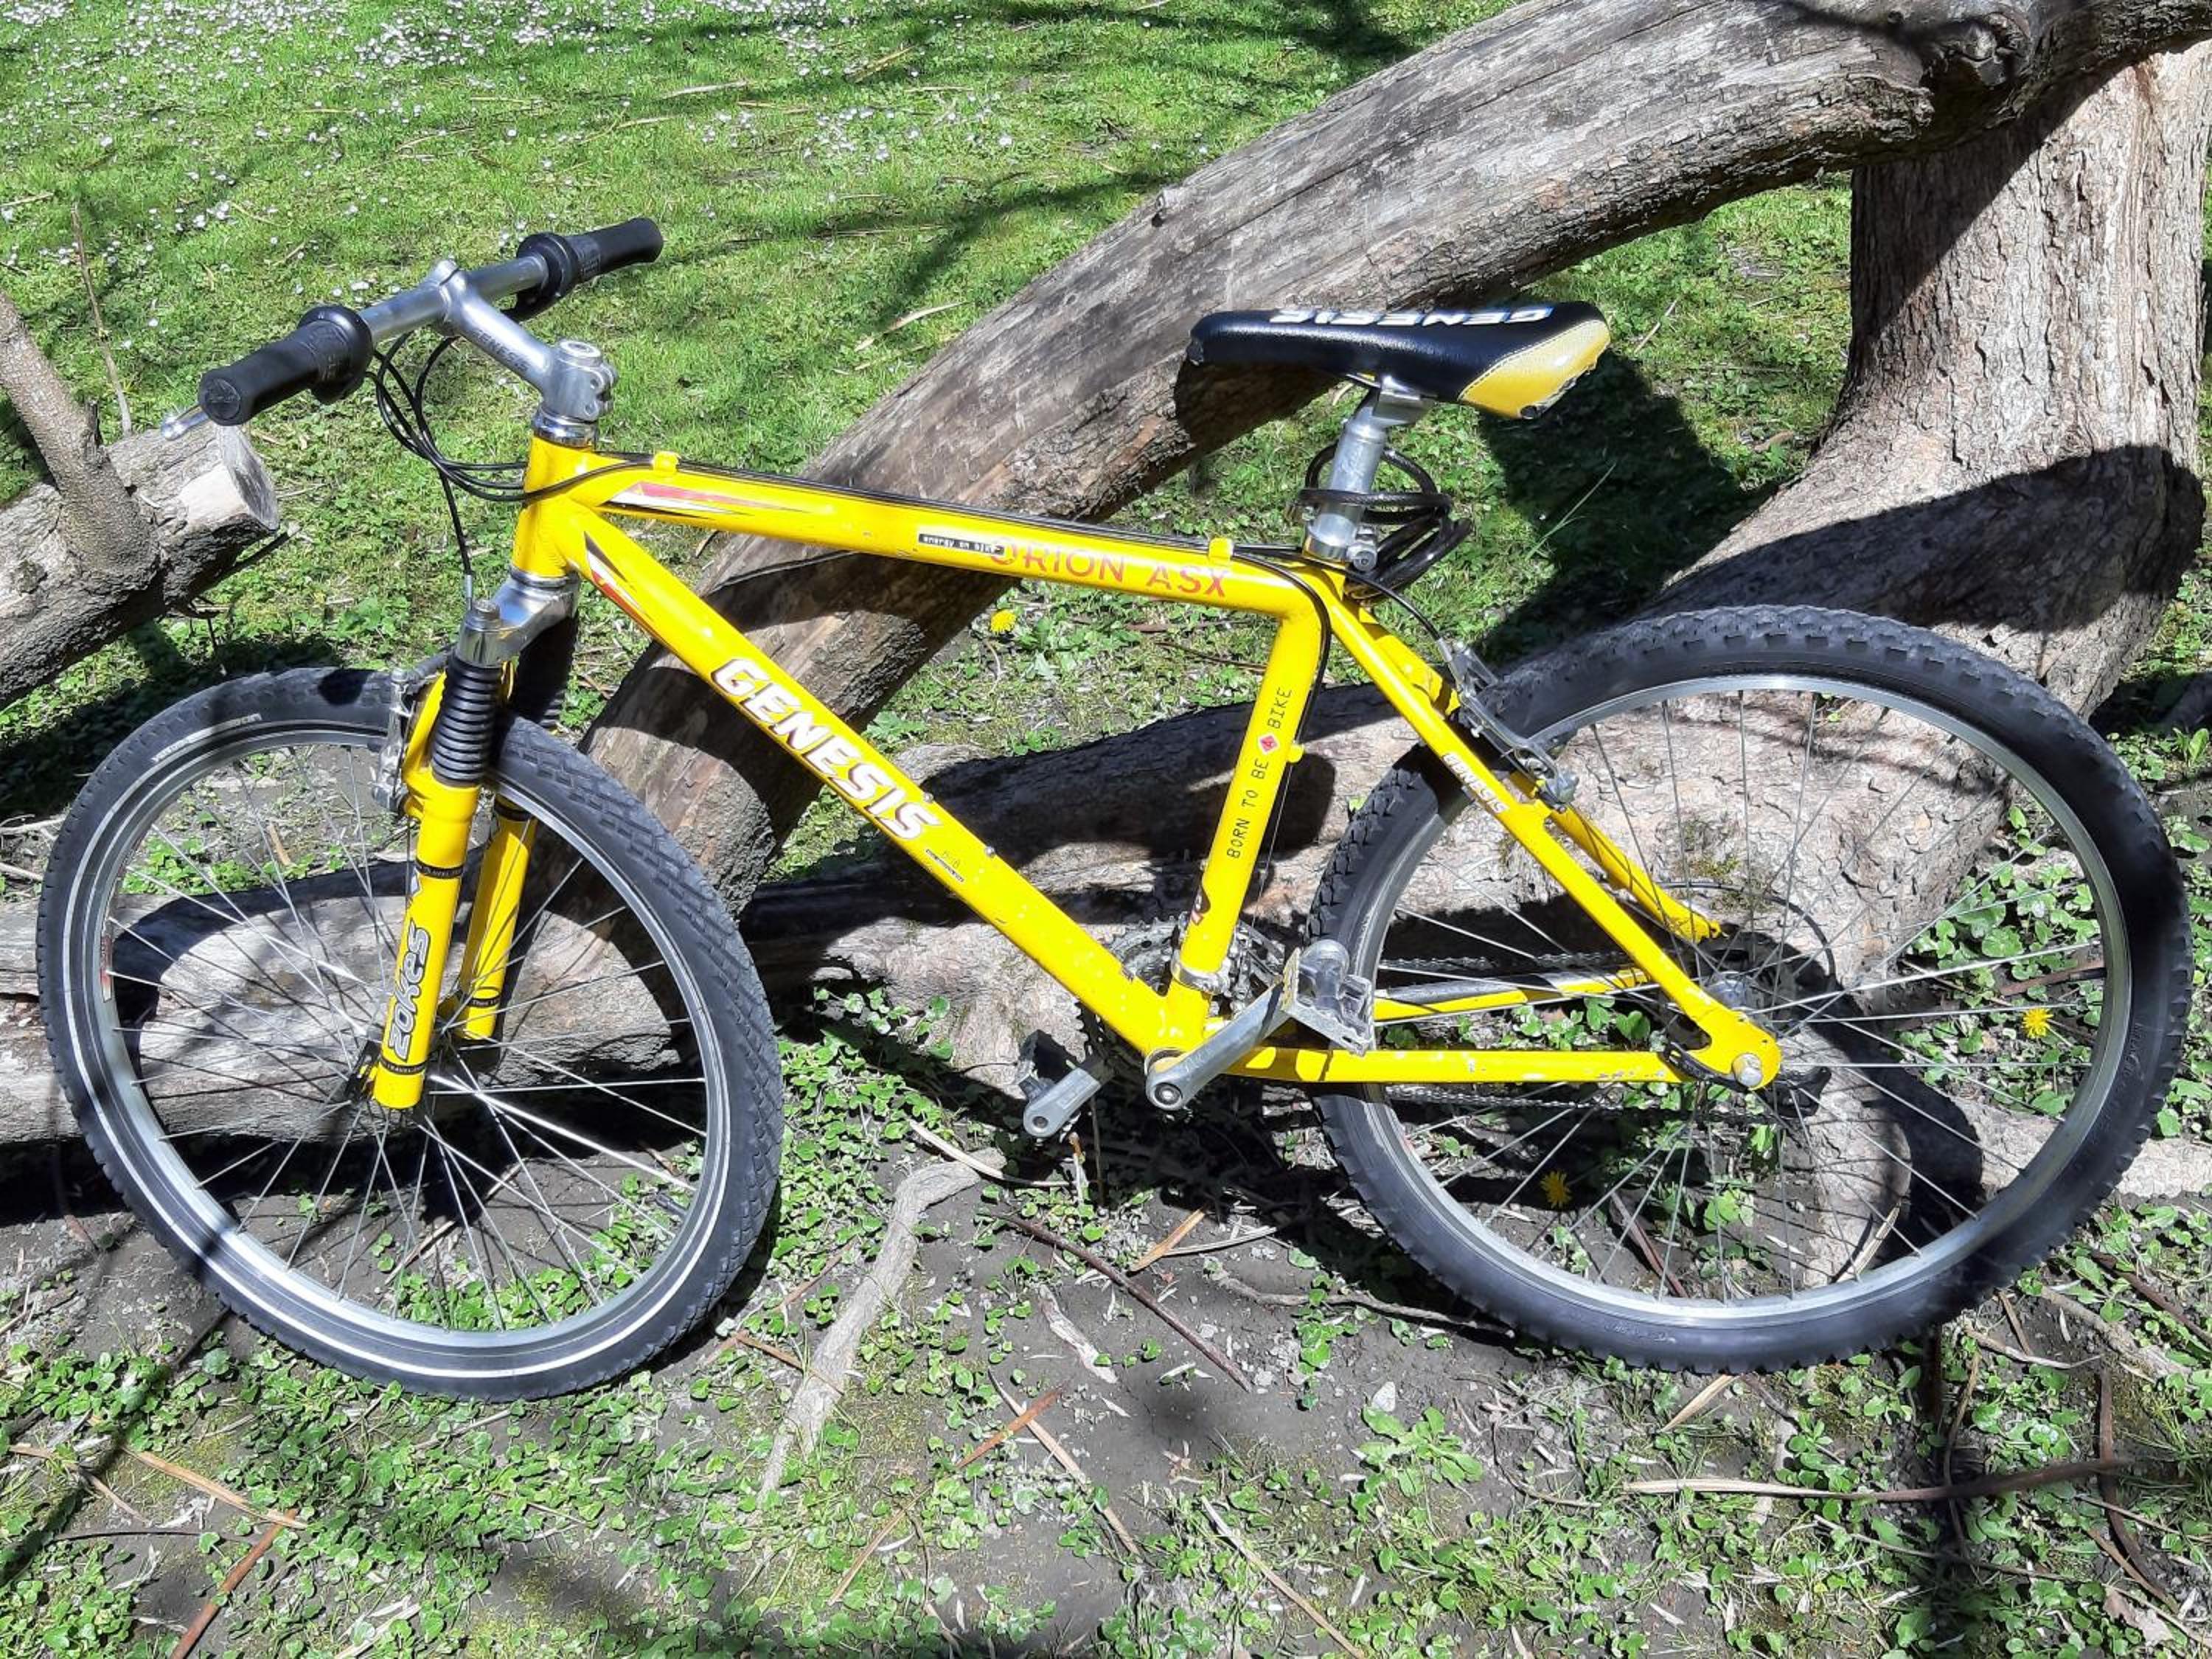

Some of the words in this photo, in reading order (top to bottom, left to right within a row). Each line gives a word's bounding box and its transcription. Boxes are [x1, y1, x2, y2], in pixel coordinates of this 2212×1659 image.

[990, 538, 1127, 582] ORION
[1145, 565, 1231, 597] ASX
[710, 658, 943, 840] GENESIS
[1226, 818, 1251, 859] BORN
[1241, 790, 1258, 807] TO
[1251, 758, 1269, 779] BE
[1267, 687, 1292, 729] BIKE
[1442, 753, 1510, 813] GENESIS
